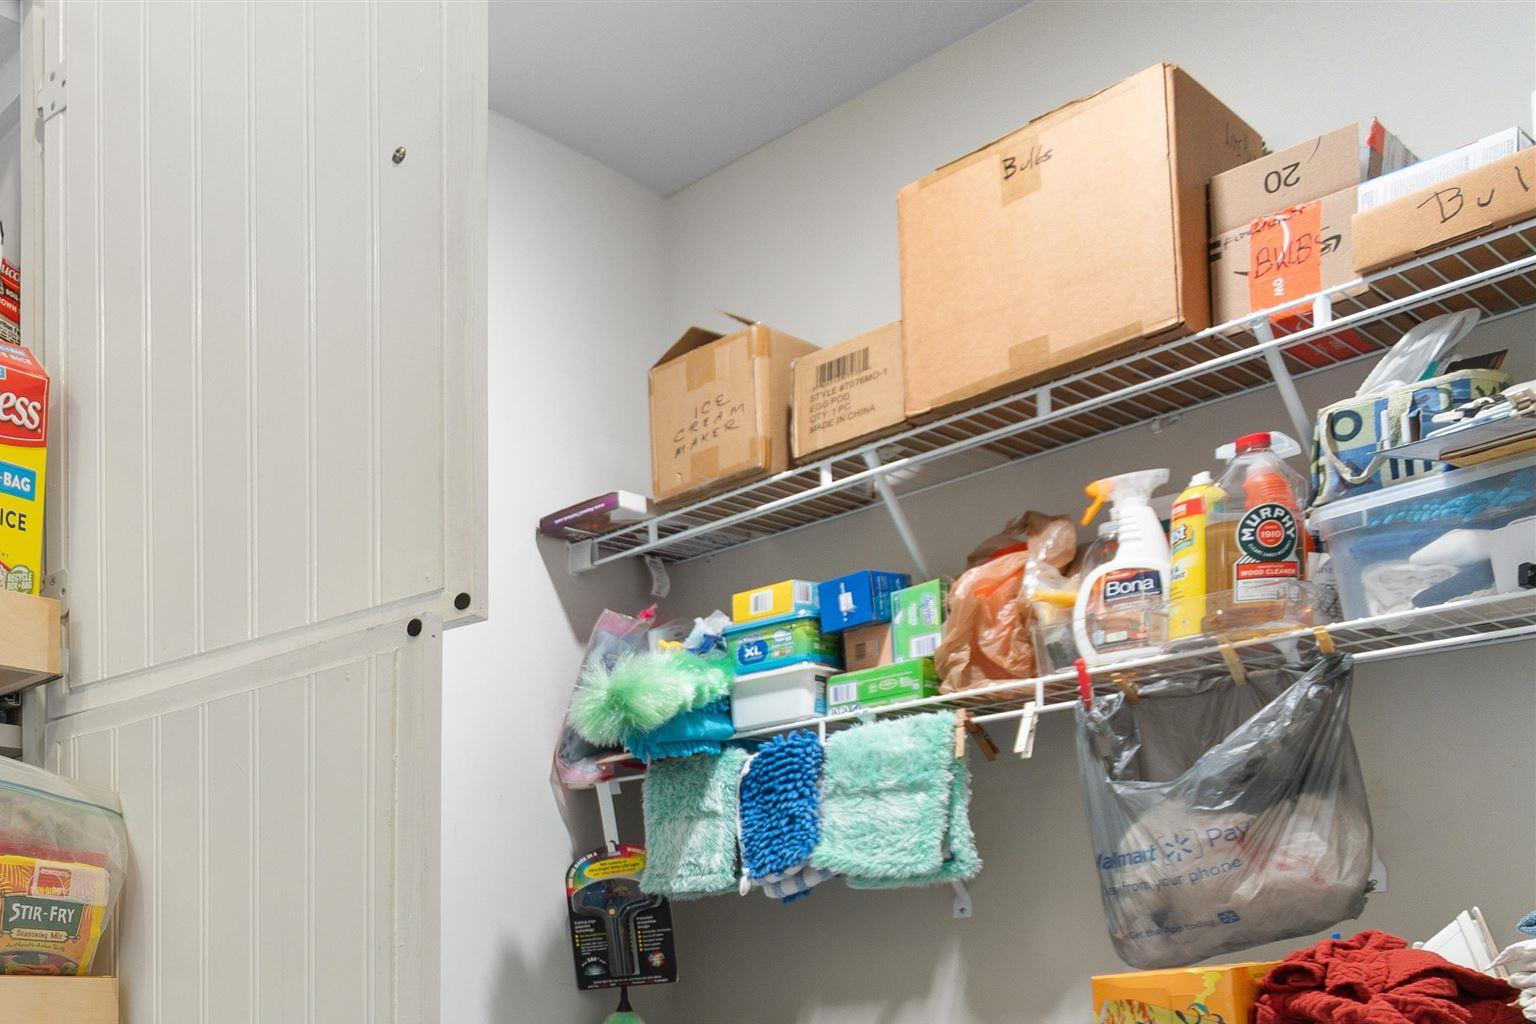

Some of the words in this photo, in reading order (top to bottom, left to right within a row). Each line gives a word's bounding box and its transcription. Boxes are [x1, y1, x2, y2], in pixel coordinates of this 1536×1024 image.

[1002, 144, 1053, 180] Bulbs
[810, 386, 837, 403] STYLE
[810, 400, 829, 413] EGG
[831, 392, 850, 405] POD
[695, 394, 730, 419] ICE
[839, 402, 851, 413] PC
[672, 403, 745, 443] CREAM
[810, 418, 834, 433] MADE
[837, 415, 845, 424] IN
[847, 404, 876, 420] CHINA
[675, 419, 741, 458] MAKER
[1241, 507, 1296, 542] MURPHY
[1260, 530, 1282, 538] 1910
[8, 571, 32, 582] RECYCLE
[1241, 568, 1264, 576] WOOD
[1105, 578, 1155, 597] Bona
[744, 645, 763, 658] XL
[1205, 822, 1251, 847] Pay
[1155, 875, 1183, 891] your
[1189, 858, 1242, 885] phone
[9, 903, 75, 923] STIR-FRY
[16, 930, 48, 940] Seasoning
[50, 931, 64, 940] Mix
